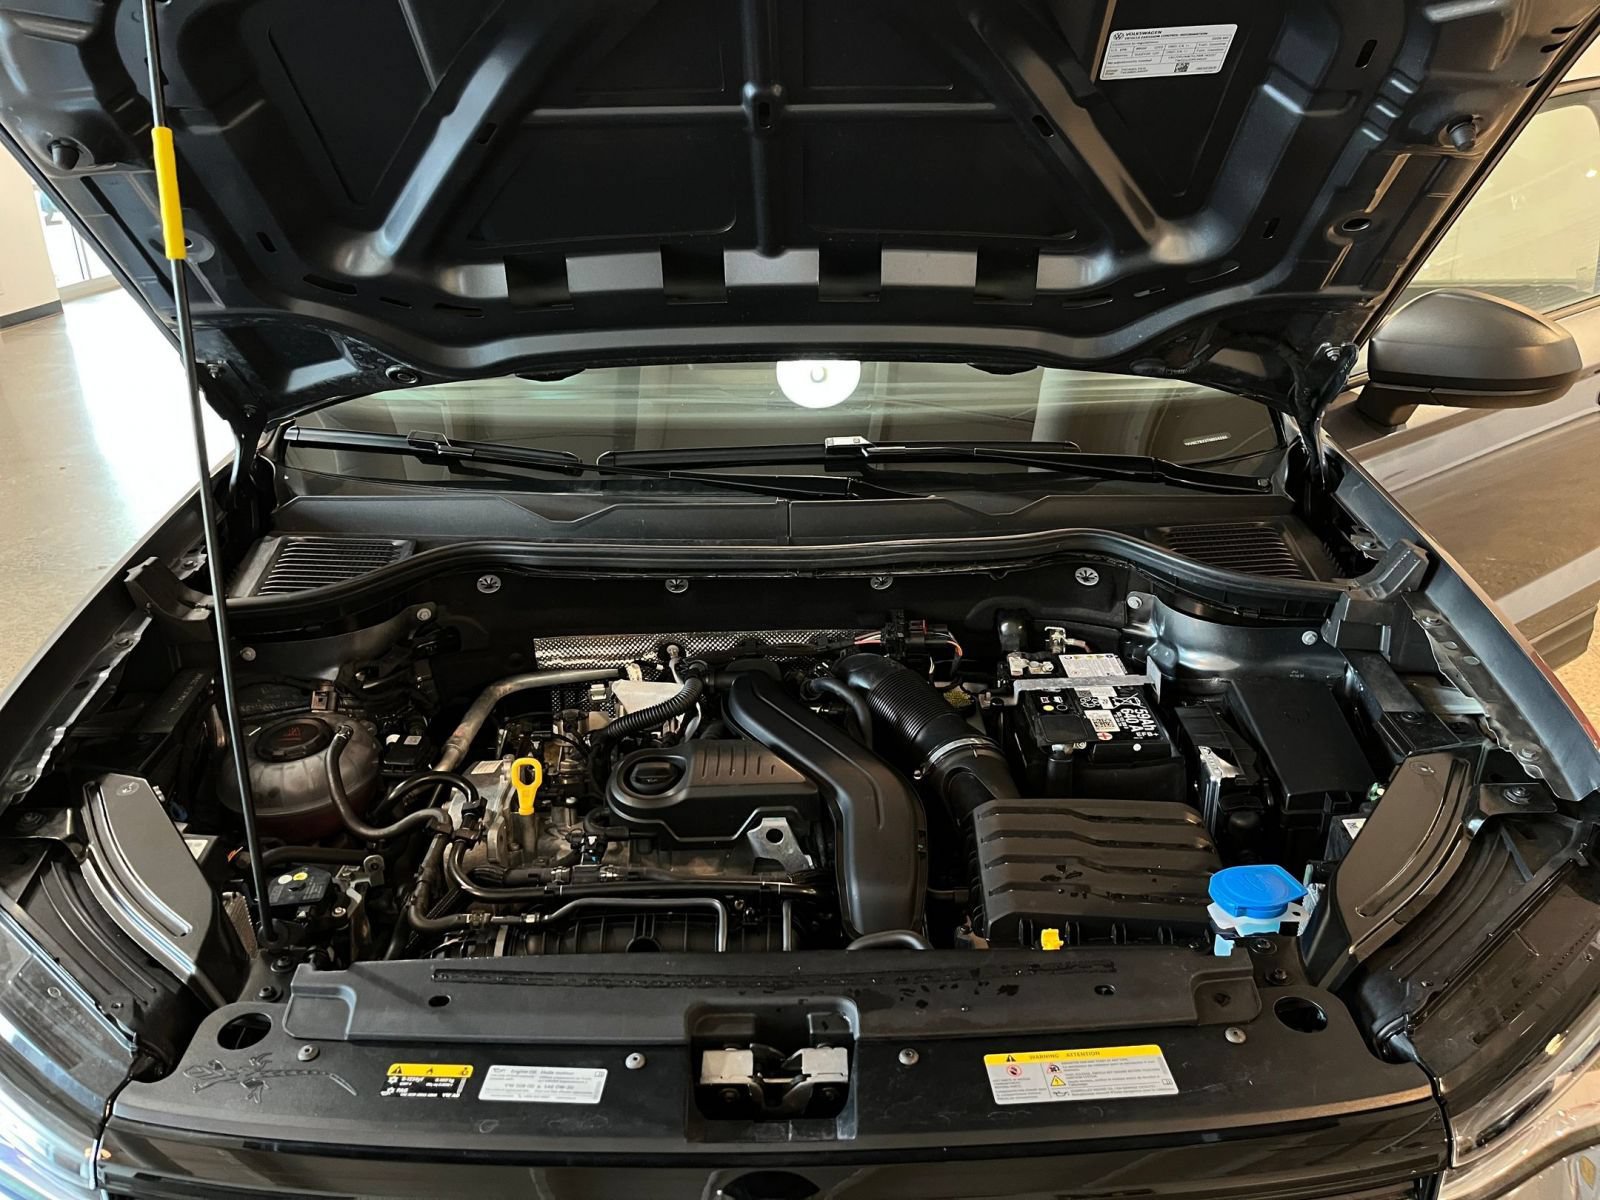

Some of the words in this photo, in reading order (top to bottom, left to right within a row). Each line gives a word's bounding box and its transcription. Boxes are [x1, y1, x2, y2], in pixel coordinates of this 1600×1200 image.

[1120, 708, 1140, 724] 640
[1134, 708, 1157, 731] 59Ah
[1128, 724, 1144, 732] A
